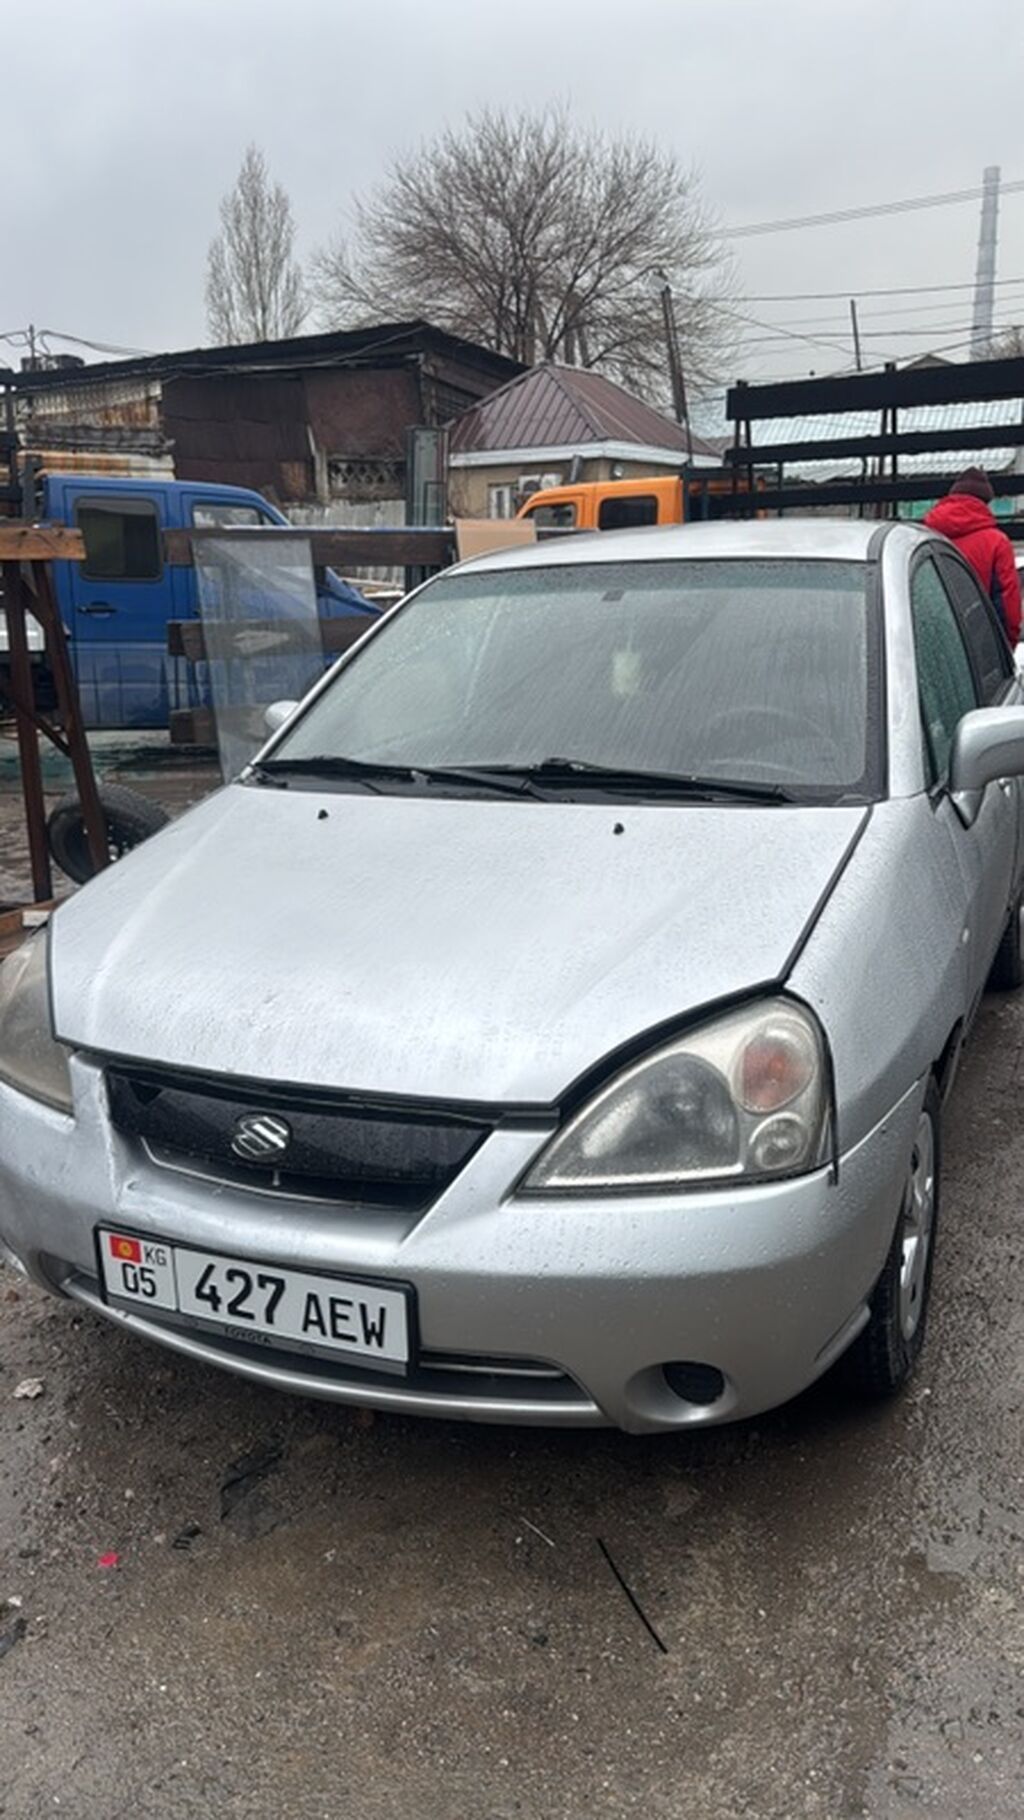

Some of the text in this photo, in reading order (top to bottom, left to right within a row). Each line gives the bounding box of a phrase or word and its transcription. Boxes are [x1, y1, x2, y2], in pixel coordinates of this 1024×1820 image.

[143, 1245, 167, 1266] KG
[121, 1262, 156, 1297] 05
[194, 1263, 386, 1348] 427 AEW
